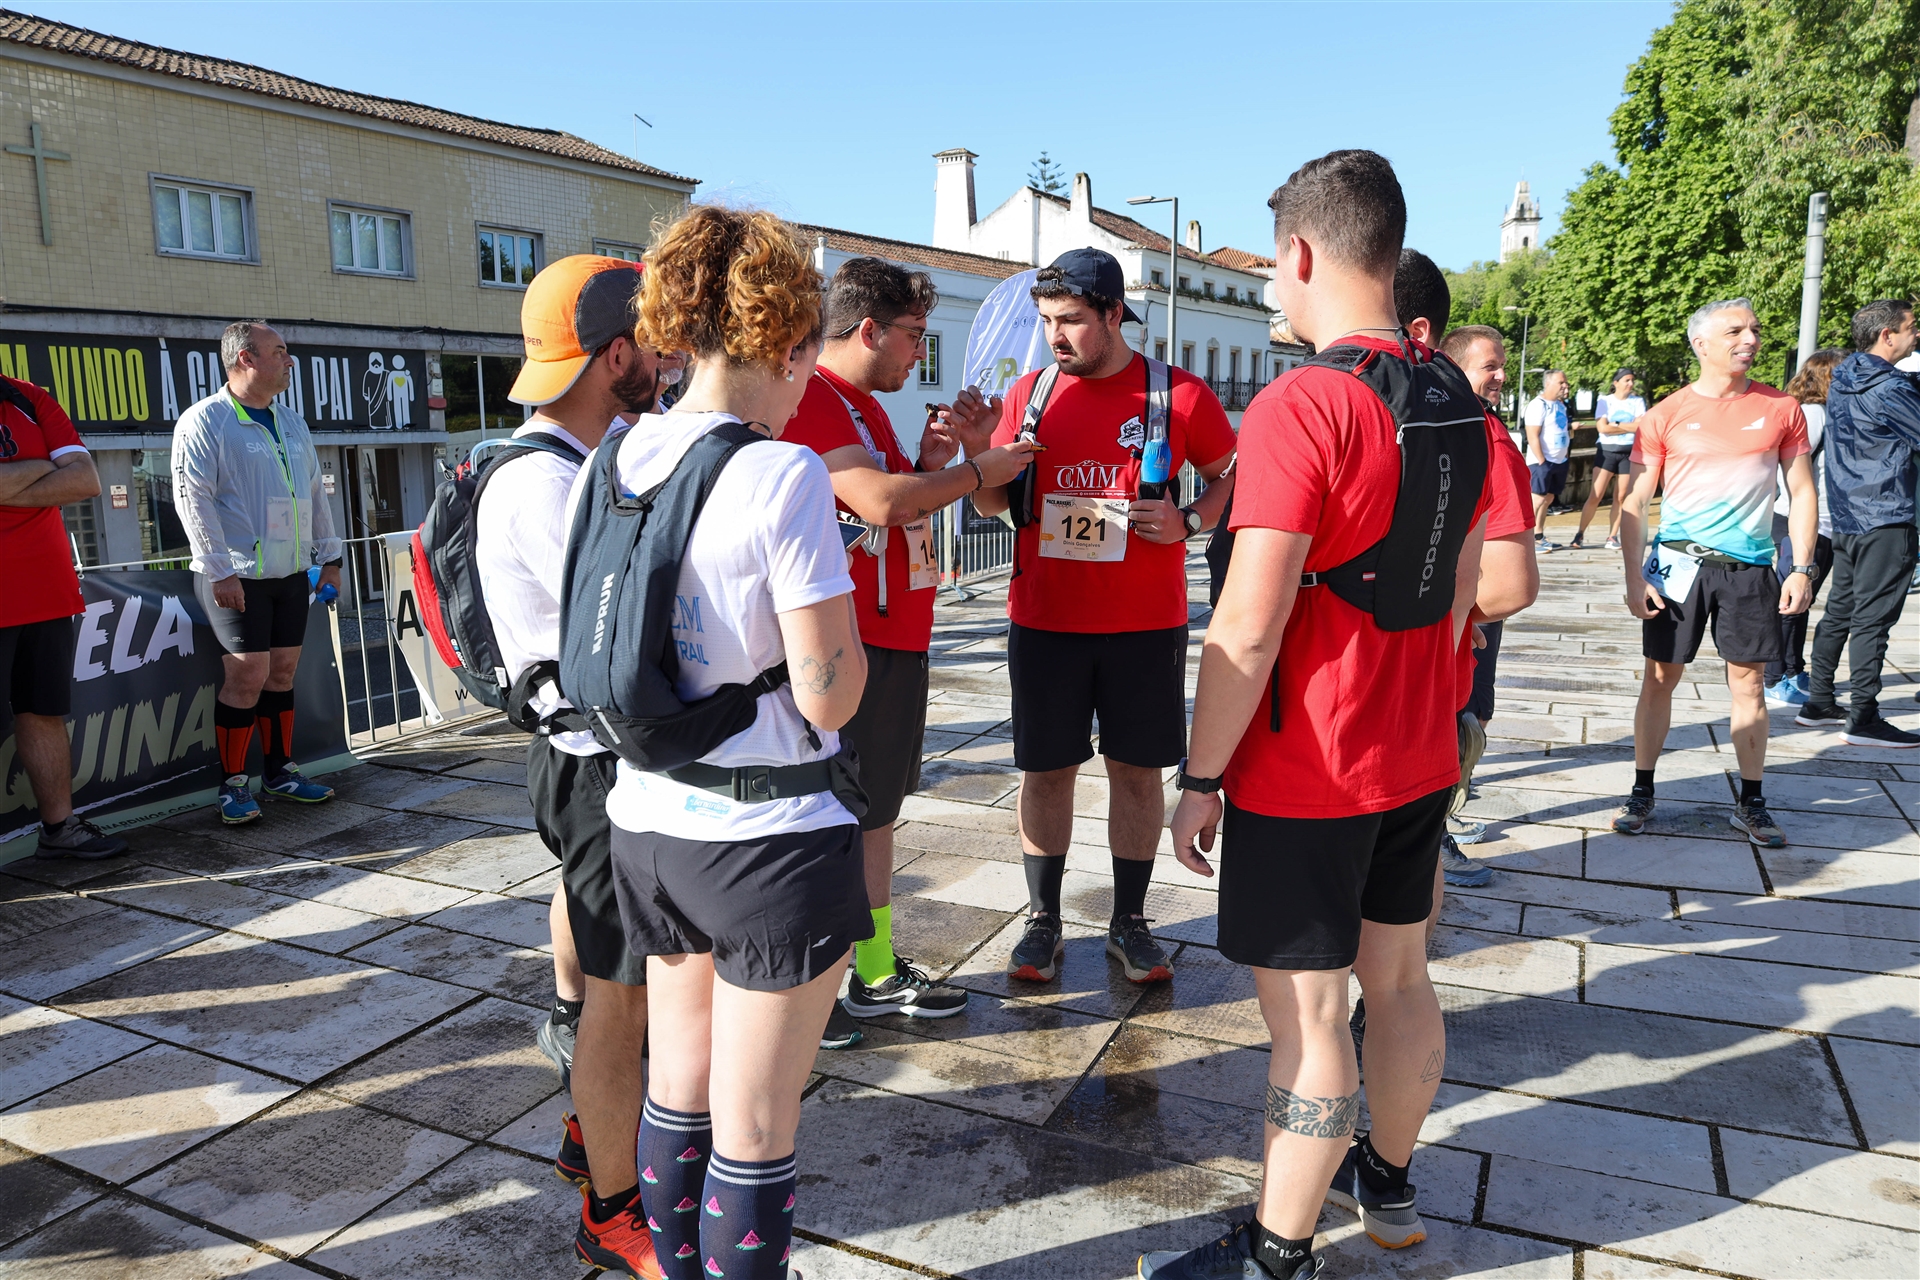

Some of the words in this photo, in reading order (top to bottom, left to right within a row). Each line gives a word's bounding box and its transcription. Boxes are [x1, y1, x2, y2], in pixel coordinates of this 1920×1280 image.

[158, 337, 180, 421] À
[311, 356, 353, 421] PAI
[1061, 515, 1106, 542] 121
[1648, 557, 1673, 581] 94
[1264, 1239, 1305, 1259] FILA
